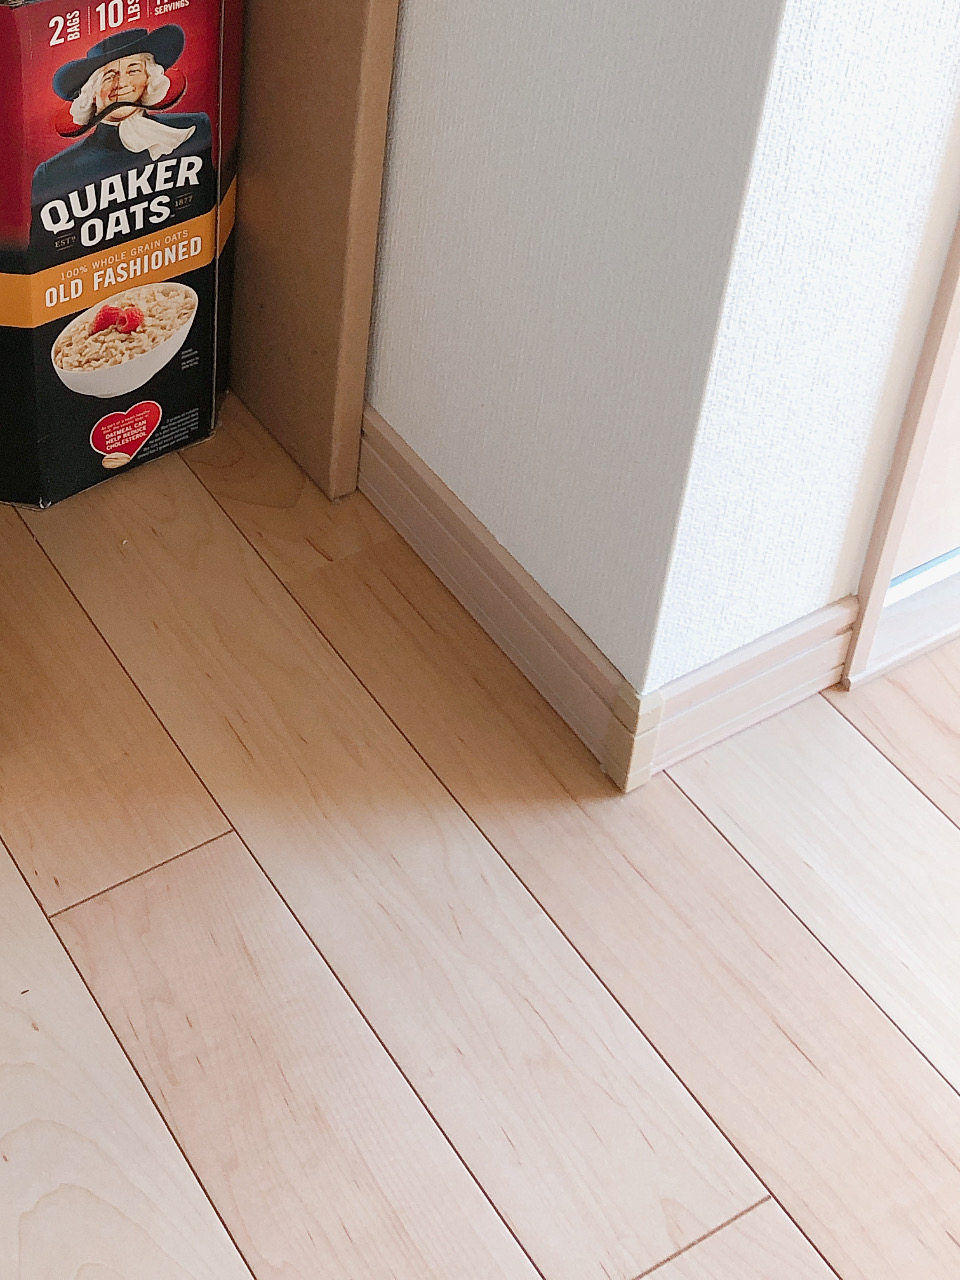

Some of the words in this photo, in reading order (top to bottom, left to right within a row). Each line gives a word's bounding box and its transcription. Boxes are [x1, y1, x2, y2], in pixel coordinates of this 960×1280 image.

[48, 15, 65, 47] 2
[66, 10, 81, 41] BAGS
[40, 155, 203, 235] QUAKER
[80, 195, 172, 247] OATS
[61, 265, 88, 280] 100%
[92, 251, 127, 270] WHOLE
[130, 239, 161, 257] GRAIN
[165, 229, 189, 244] OATS
[45, 278, 83, 308] OLD
[93, 236, 202, 291] FASHIONED
[105, 425, 133, 440] OATMEAL
[134, 419, 147, 428] CAN
[105, 435, 122, 445] HELP
[106, 432, 147, 451] CHOLESTEROL
